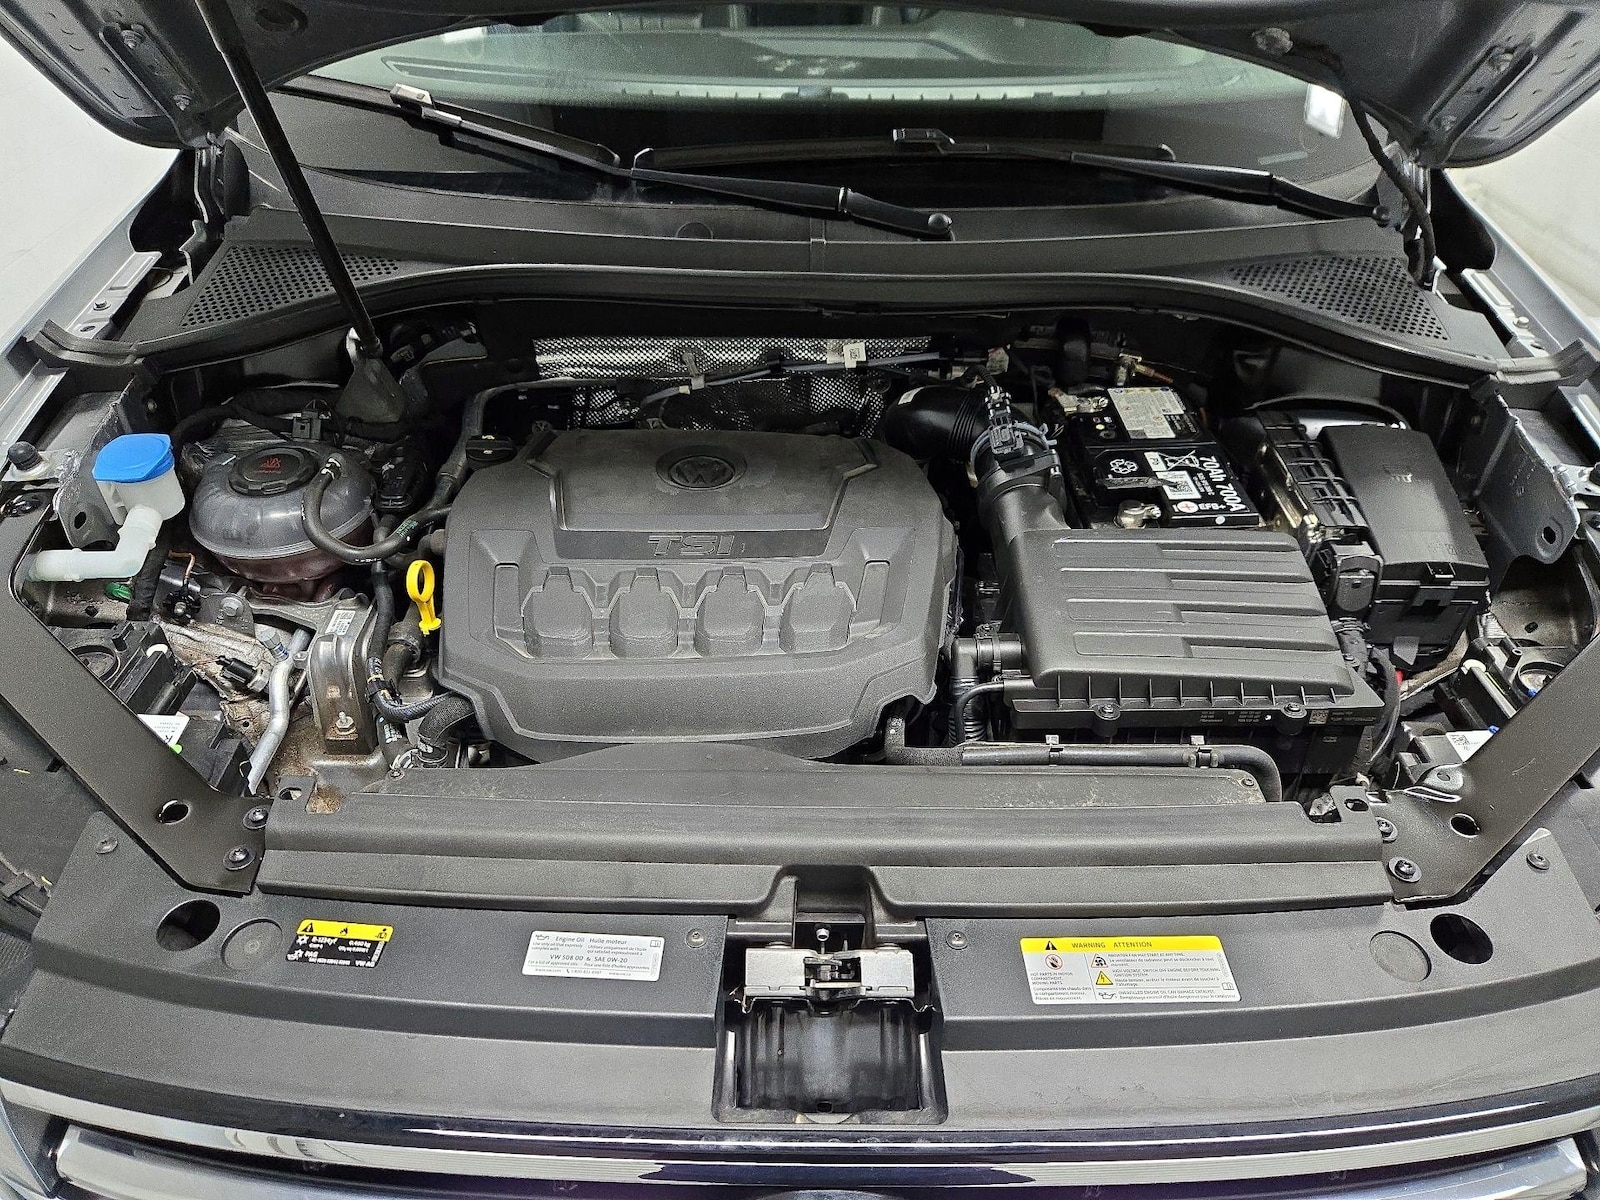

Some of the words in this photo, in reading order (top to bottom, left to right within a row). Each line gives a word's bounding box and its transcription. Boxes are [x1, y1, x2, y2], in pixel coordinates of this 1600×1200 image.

[1200, 456, 1226, 482] 70Ah
[1216, 482, 1248, 512] 700A
[648, 535, 735, 556] TSI
